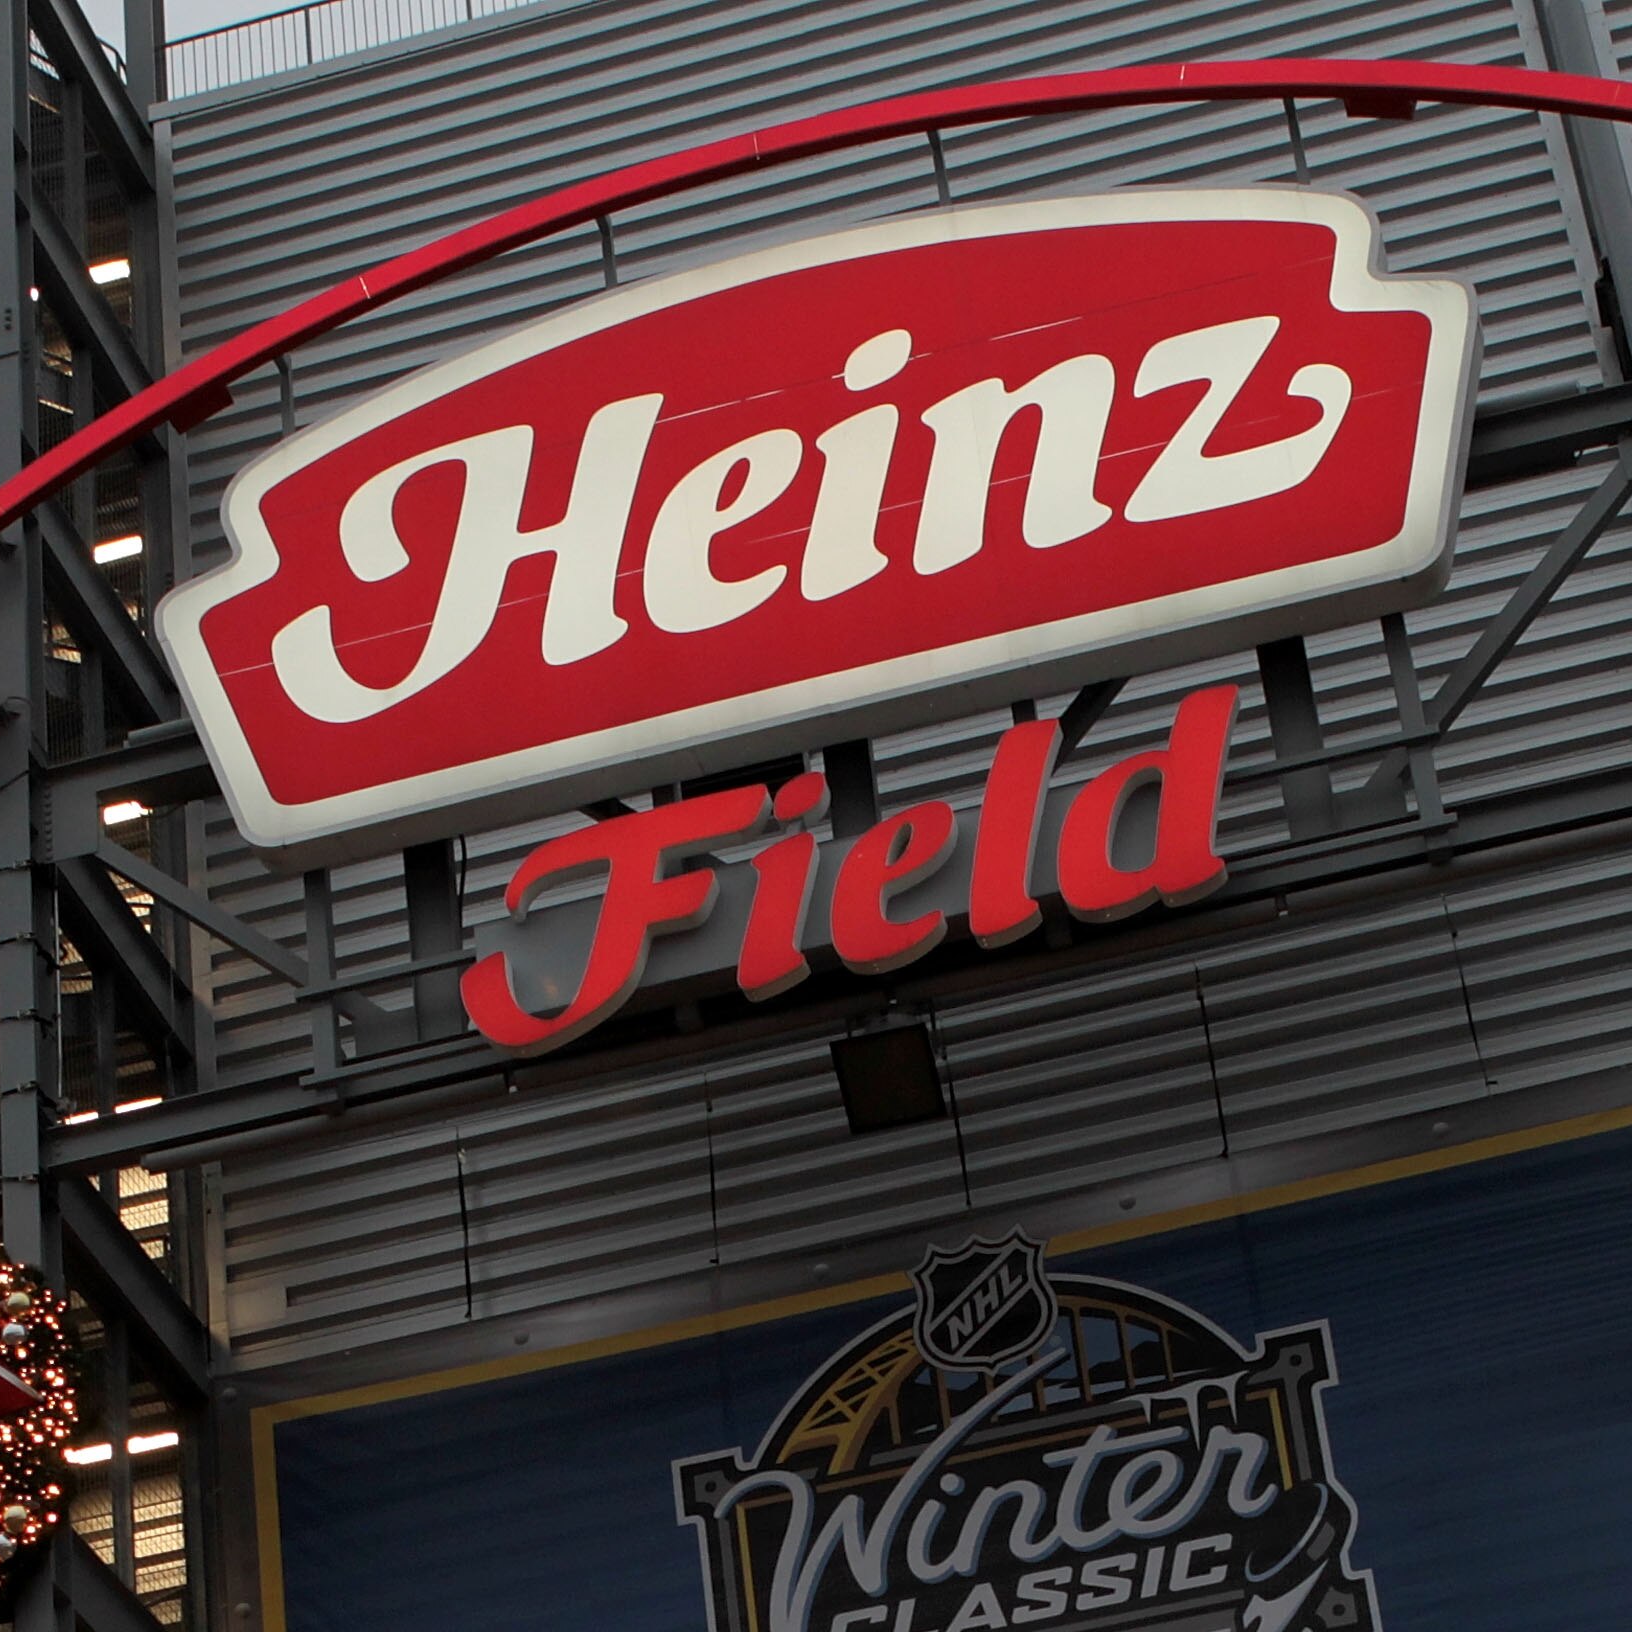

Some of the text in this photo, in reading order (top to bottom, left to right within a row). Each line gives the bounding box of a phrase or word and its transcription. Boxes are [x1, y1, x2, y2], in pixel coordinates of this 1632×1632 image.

[271, 314, 1353, 724] Heinz
[459, 684, 1241, 1059] Field
[945, 1263, 1030, 1352] NHL
